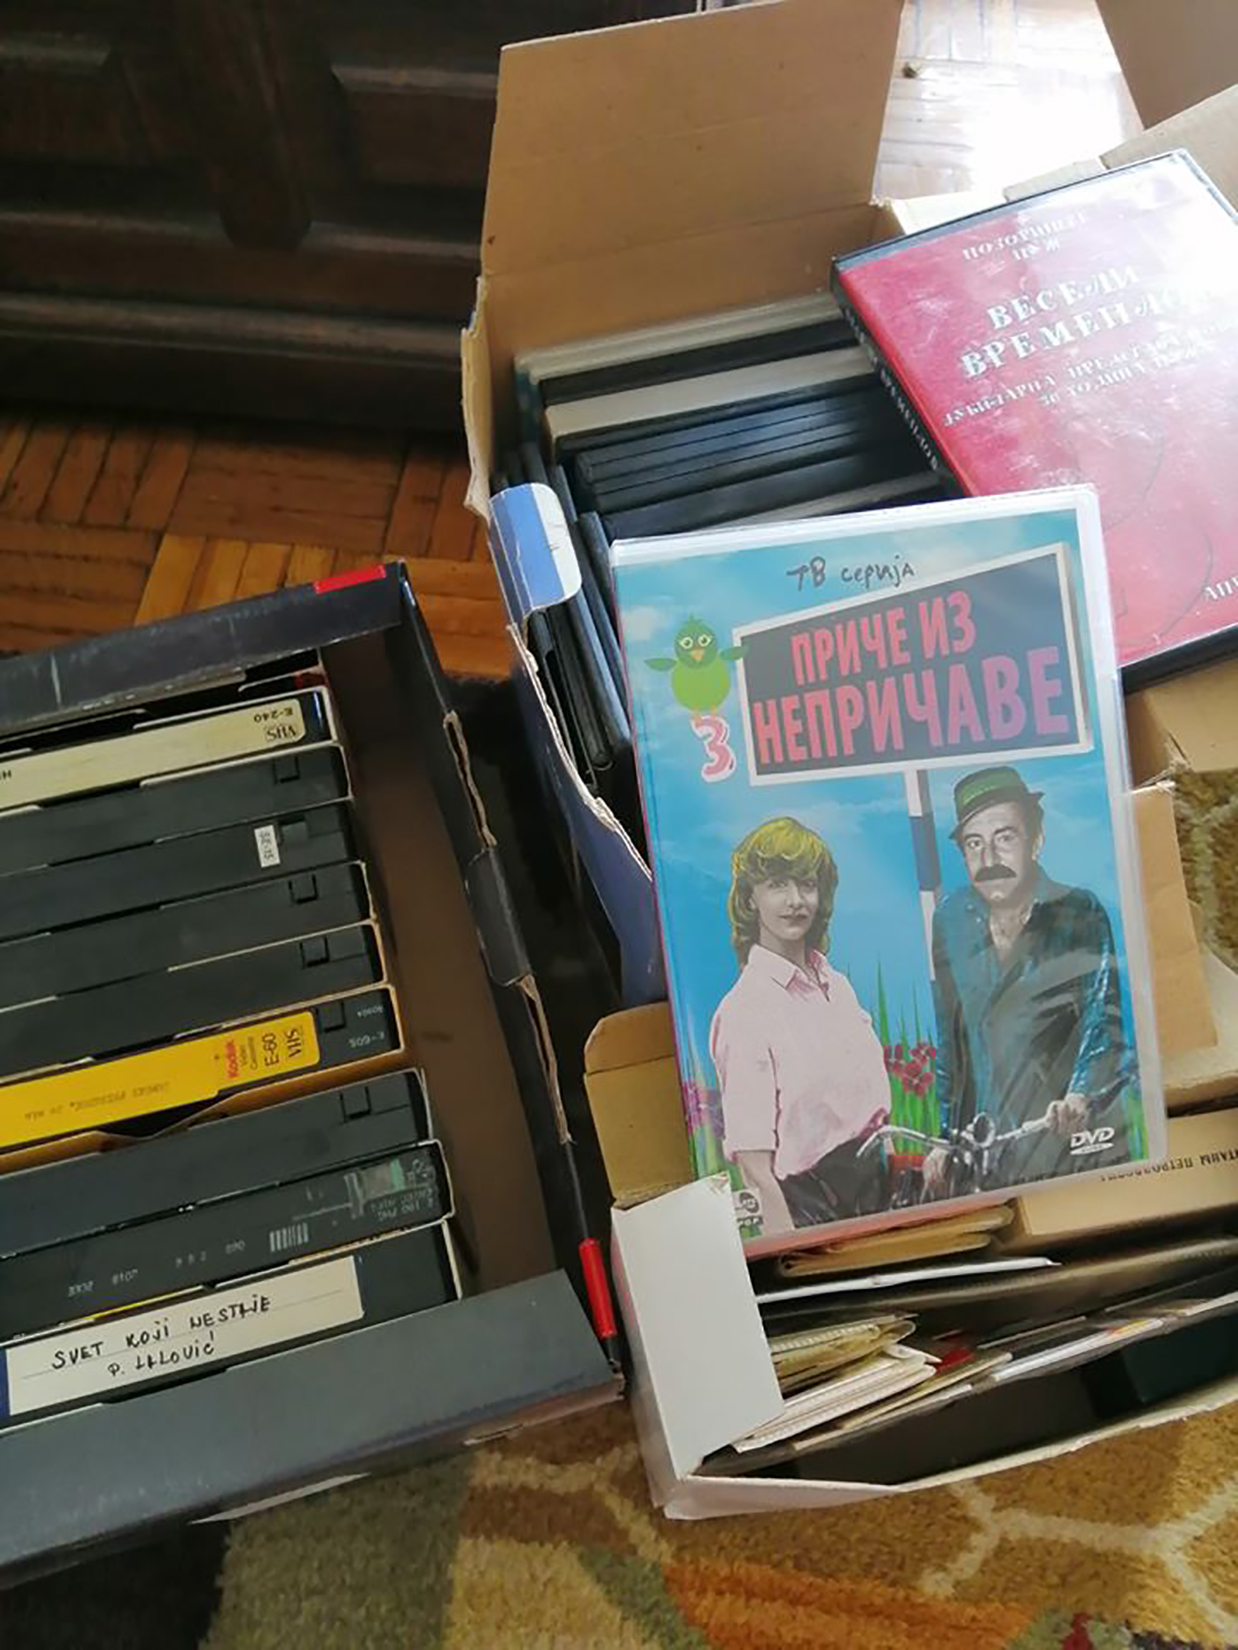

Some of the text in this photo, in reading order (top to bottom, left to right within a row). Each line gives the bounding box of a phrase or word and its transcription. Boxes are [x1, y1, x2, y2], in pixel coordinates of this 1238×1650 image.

[987, 264, 1140, 331] ВЕСЕЛИ
[961, 284, 1200, 379] ВРЕМЕПЛО
[841, 554, 915, 589] серија
[790, 590, 977, 687] ПРИЧЕ ИЗ
[253, 709, 294, 724] E-240
[752, 646, 1070, 765] НЕПРИЧАВЕ
[265, 724, 297, 741] VHS
[690, 714, 738, 783] 3
[262, 1033, 280, 1067] E-60
[286, 1028, 303, 1058] VHS
[1070, 1127, 1115, 1150] DVD
[52, 1341, 105, 1370] SVET
